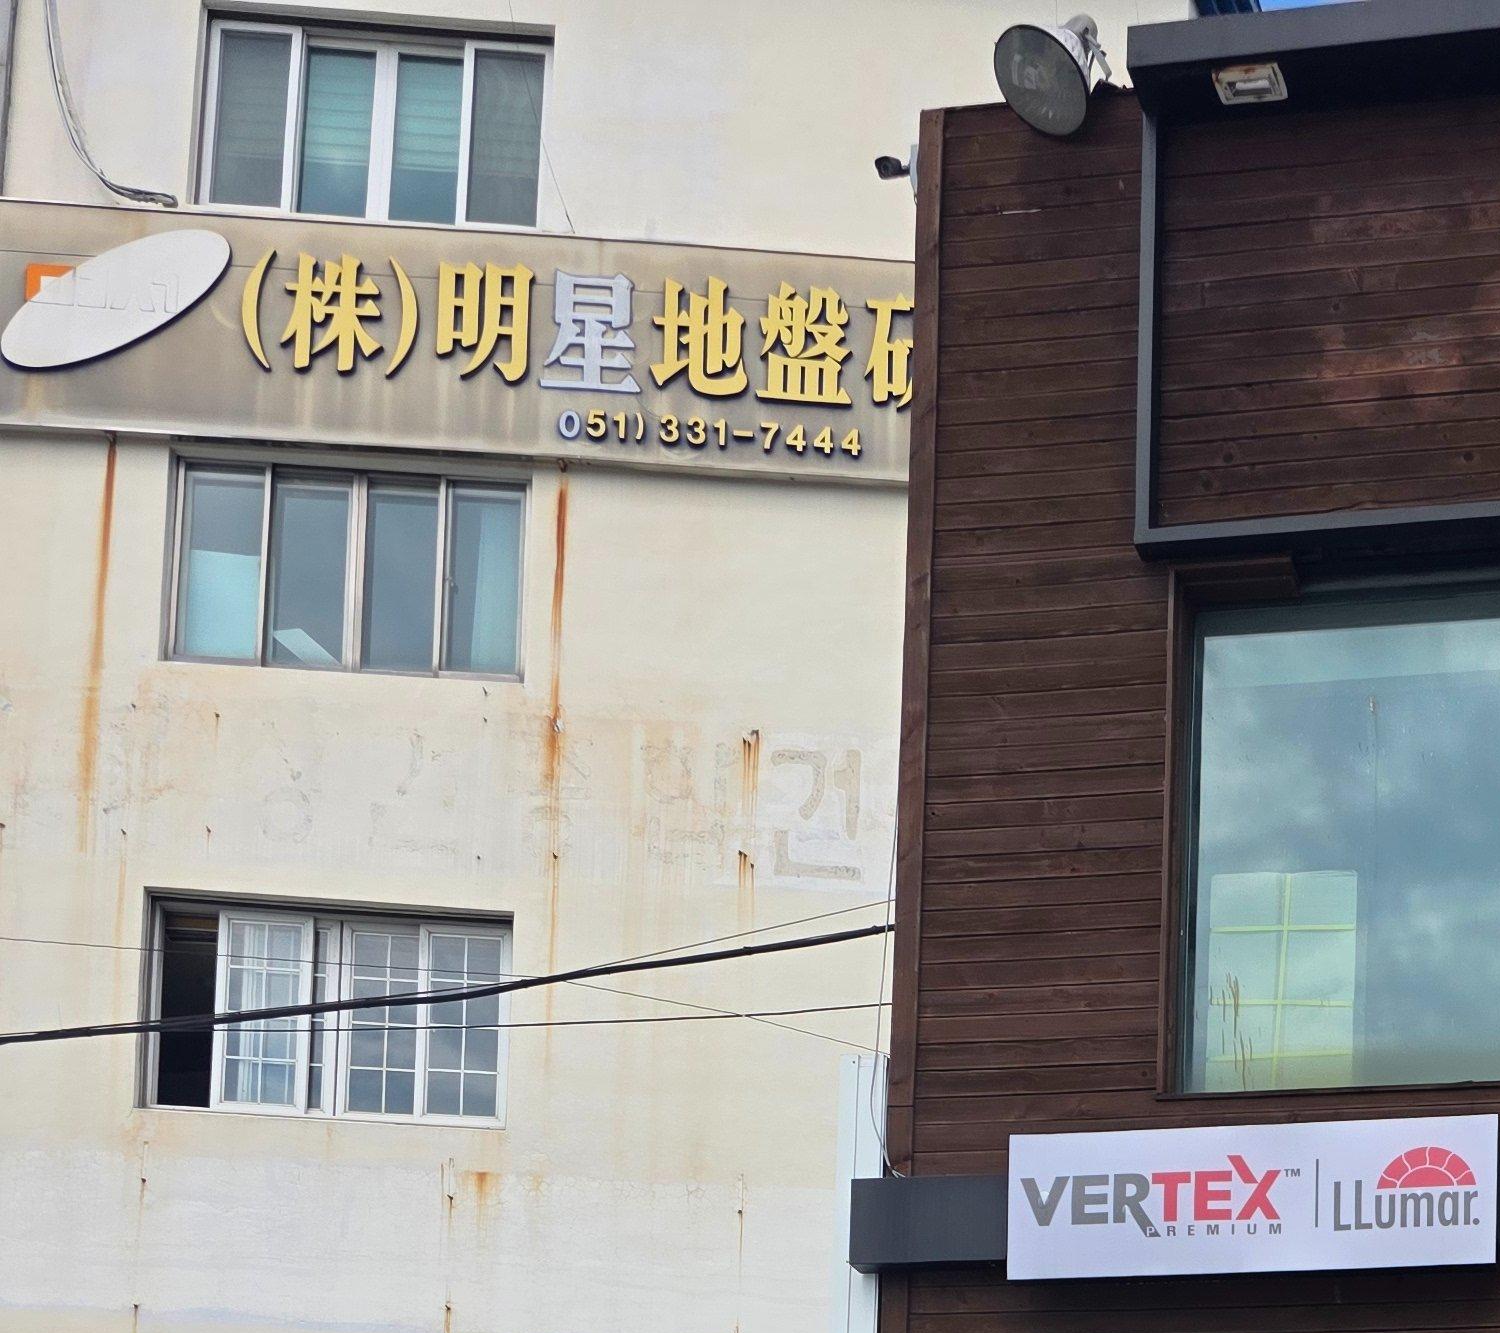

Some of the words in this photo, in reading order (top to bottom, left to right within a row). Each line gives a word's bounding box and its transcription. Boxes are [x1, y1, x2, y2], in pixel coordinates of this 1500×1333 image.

[558, 408, 644, 440] 051)
[659, 414, 862, 456] 331-7444
[1020, 1155, 1282, 1238] VERTEX
[1145, 1223, 1283, 1238] PREMIUM
